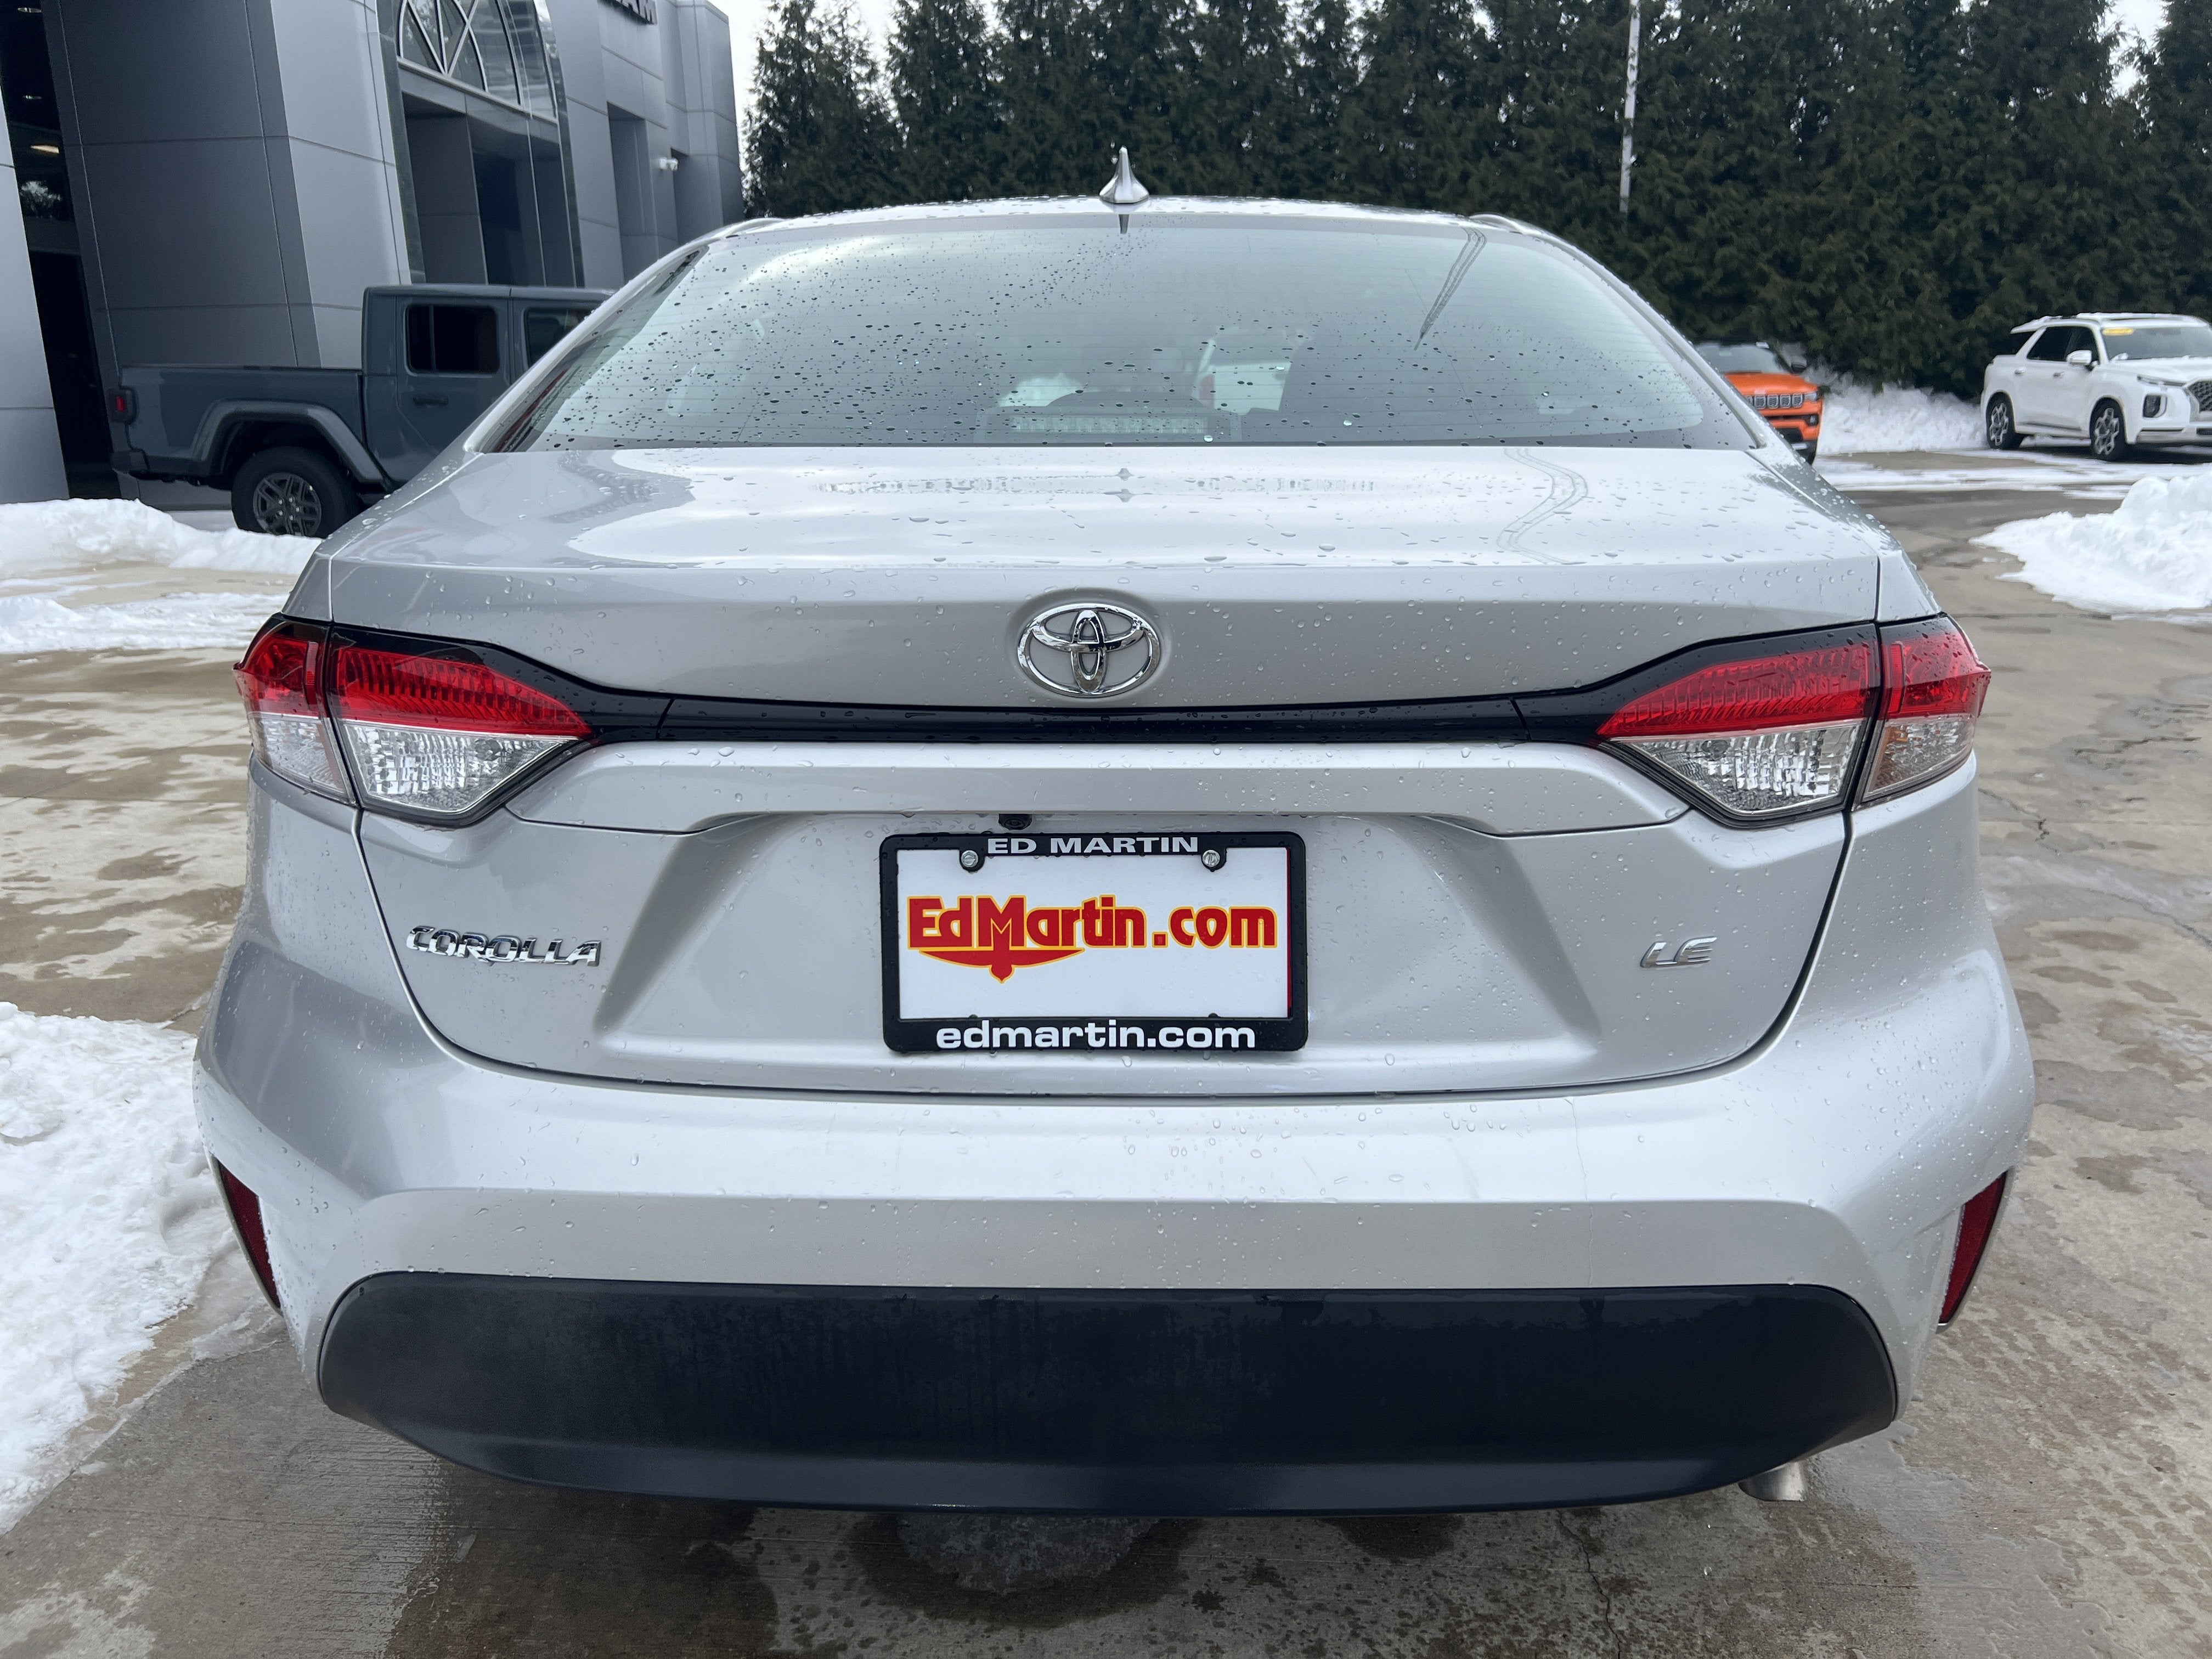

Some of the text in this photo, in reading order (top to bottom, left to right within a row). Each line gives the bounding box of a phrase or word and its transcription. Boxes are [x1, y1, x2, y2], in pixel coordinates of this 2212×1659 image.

[987, 837, 1198, 854] ED MARTIN
[906, 894, 1278, 950] EdMartin.com
[406, 925, 602, 967] COROLLA
[1640, 936, 1717, 968] LE
[936, 1019, 1256, 1048] edmartin.com
